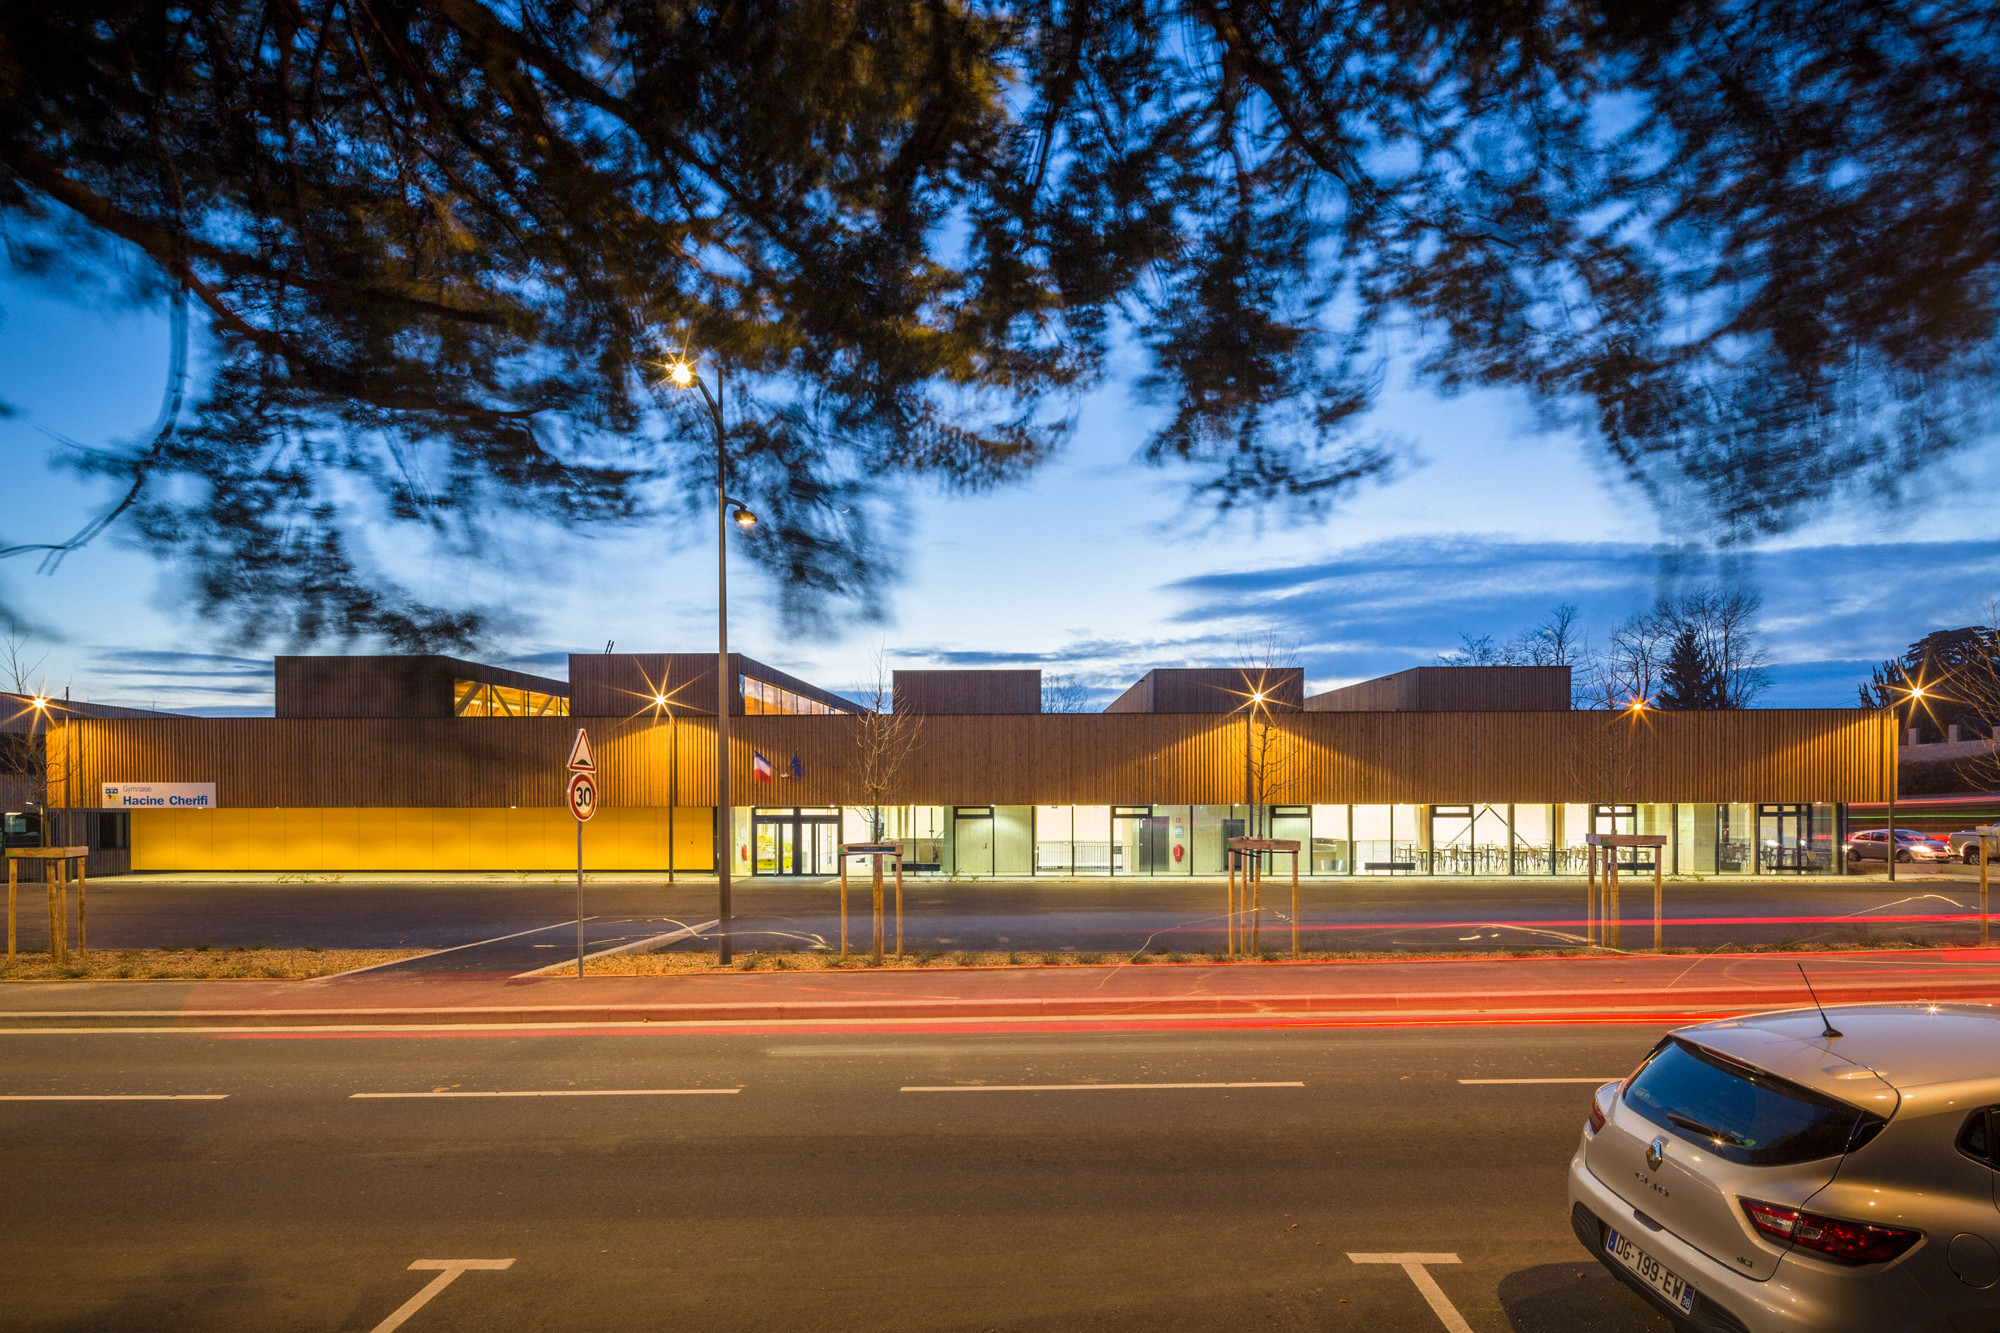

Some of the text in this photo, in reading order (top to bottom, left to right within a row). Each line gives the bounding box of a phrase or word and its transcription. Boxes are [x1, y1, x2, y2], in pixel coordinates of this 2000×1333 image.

[122, 785, 152, 793] Gymnase
[123, 795, 208, 806] Hacine Cherifi
[576, 786, 592, 807] 30
[1615, 1235, 1684, 1300] DG-199-EW
[1681, 1295, 1691, 1309] 38
